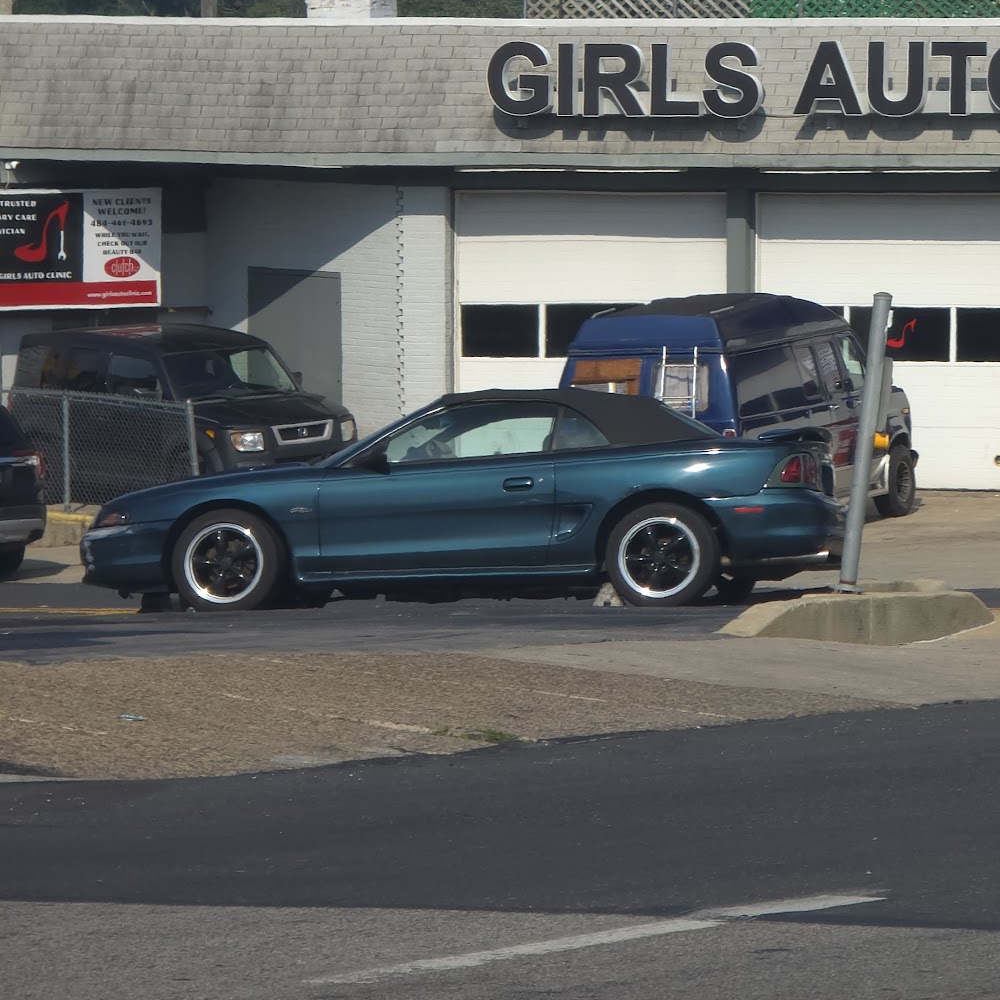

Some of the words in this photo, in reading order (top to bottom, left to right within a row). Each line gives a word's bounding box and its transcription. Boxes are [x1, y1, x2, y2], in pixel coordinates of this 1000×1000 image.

[487, 40, 765, 118] GIRLS
[115, 198, 152, 206] CLIENTS
[97, 207, 146, 216] WELCOME!
[90, 219, 153, 227] 484-461-4693
[46, 271, 72, 279] CLINIC
